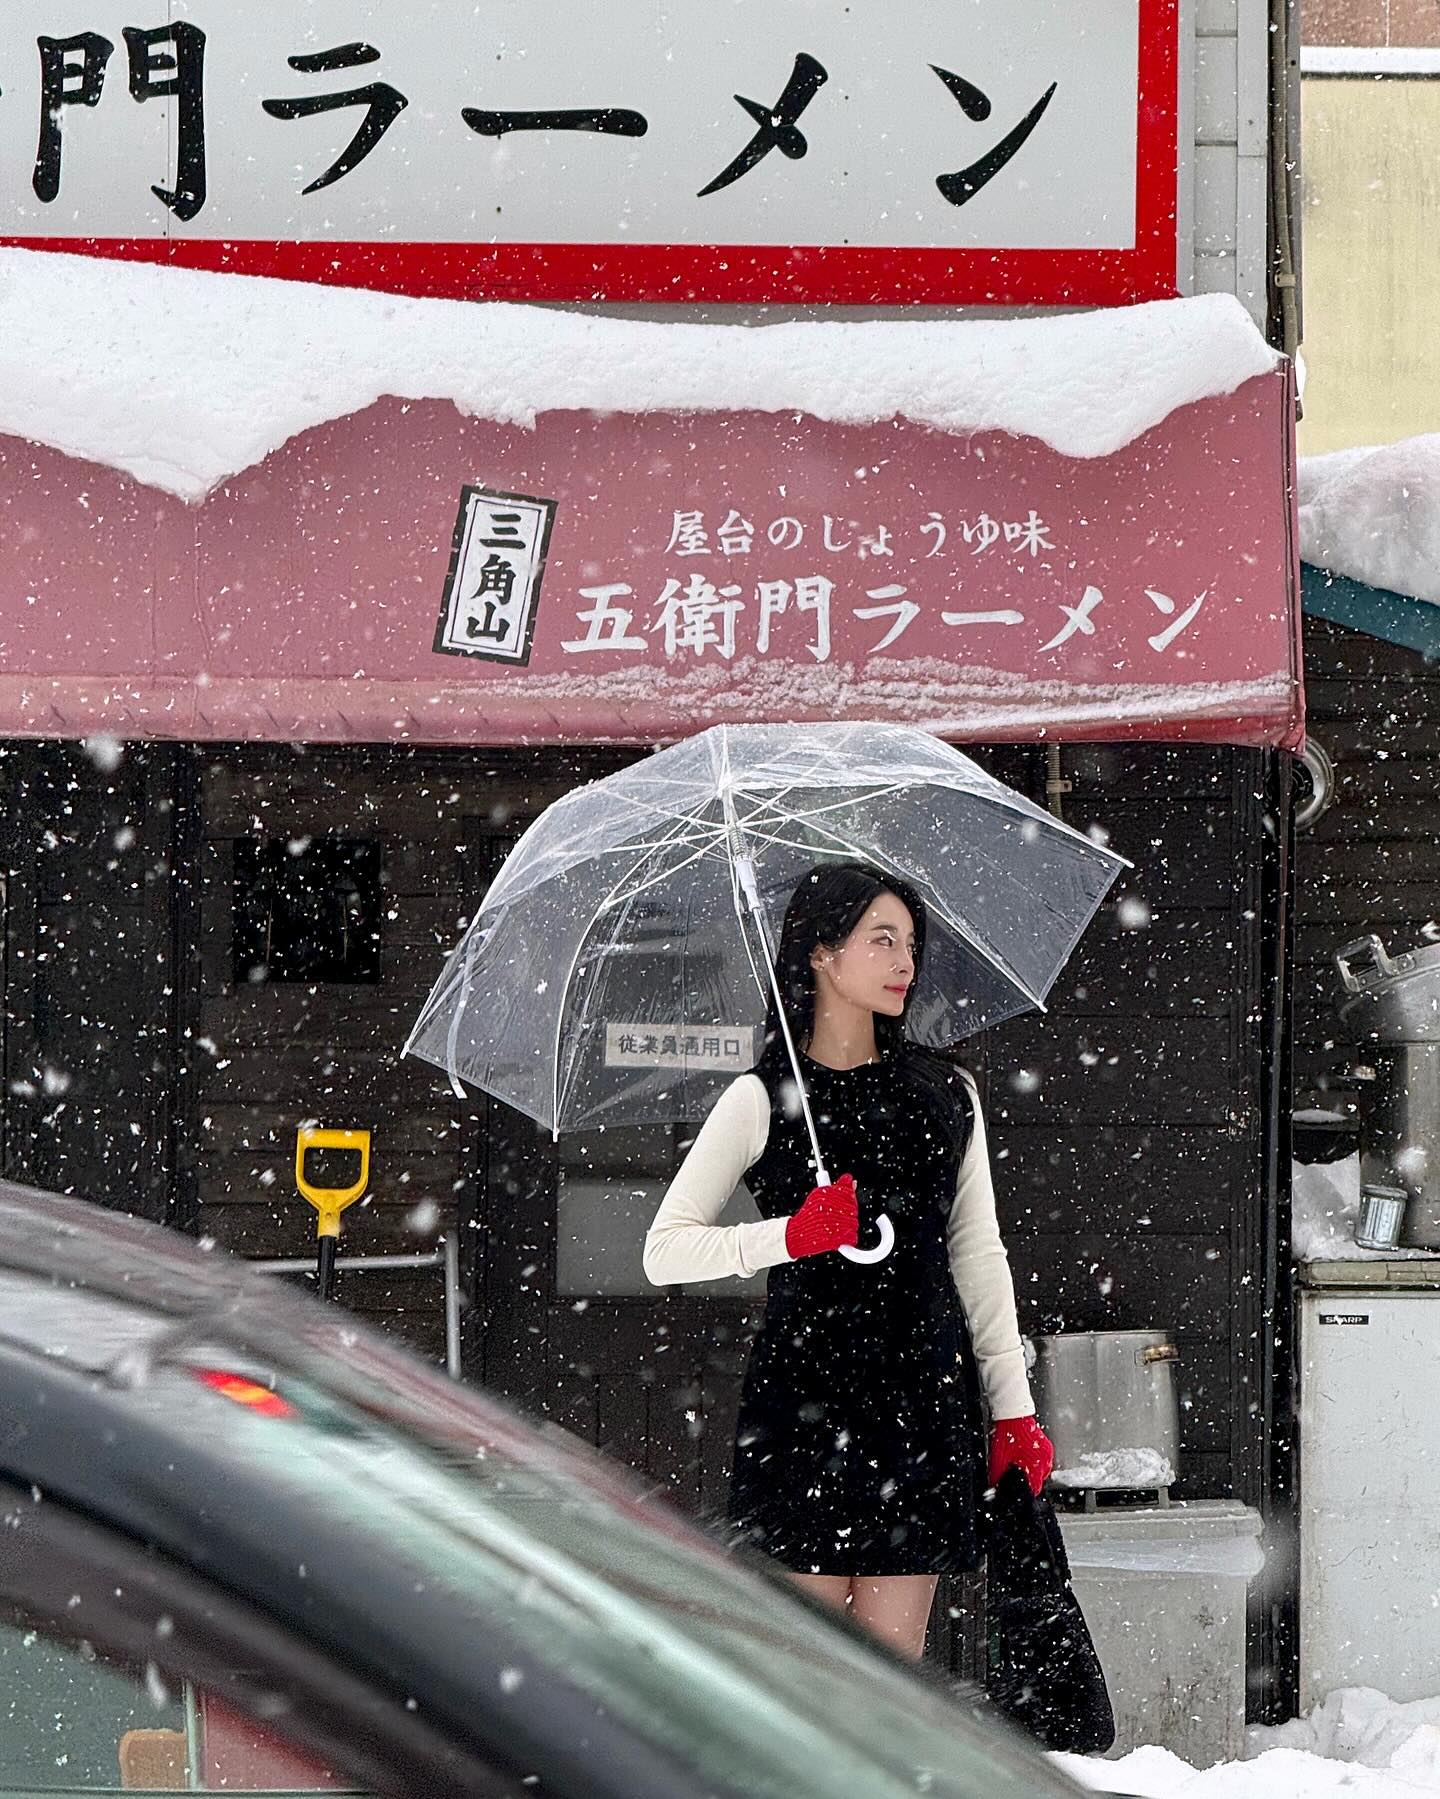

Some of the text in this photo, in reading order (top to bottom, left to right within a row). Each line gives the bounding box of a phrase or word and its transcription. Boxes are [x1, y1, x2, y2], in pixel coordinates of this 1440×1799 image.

[0, 21, 1058, 222] 門ラーメン
[466, 512, 527, 642] 三角山
[664, 509, 1056, 557] 屋台のしょうゆ味
[560, 573, 1208, 662] 五衛門ラーメン
[618, 1034, 740, 1058] 従業員通用口
